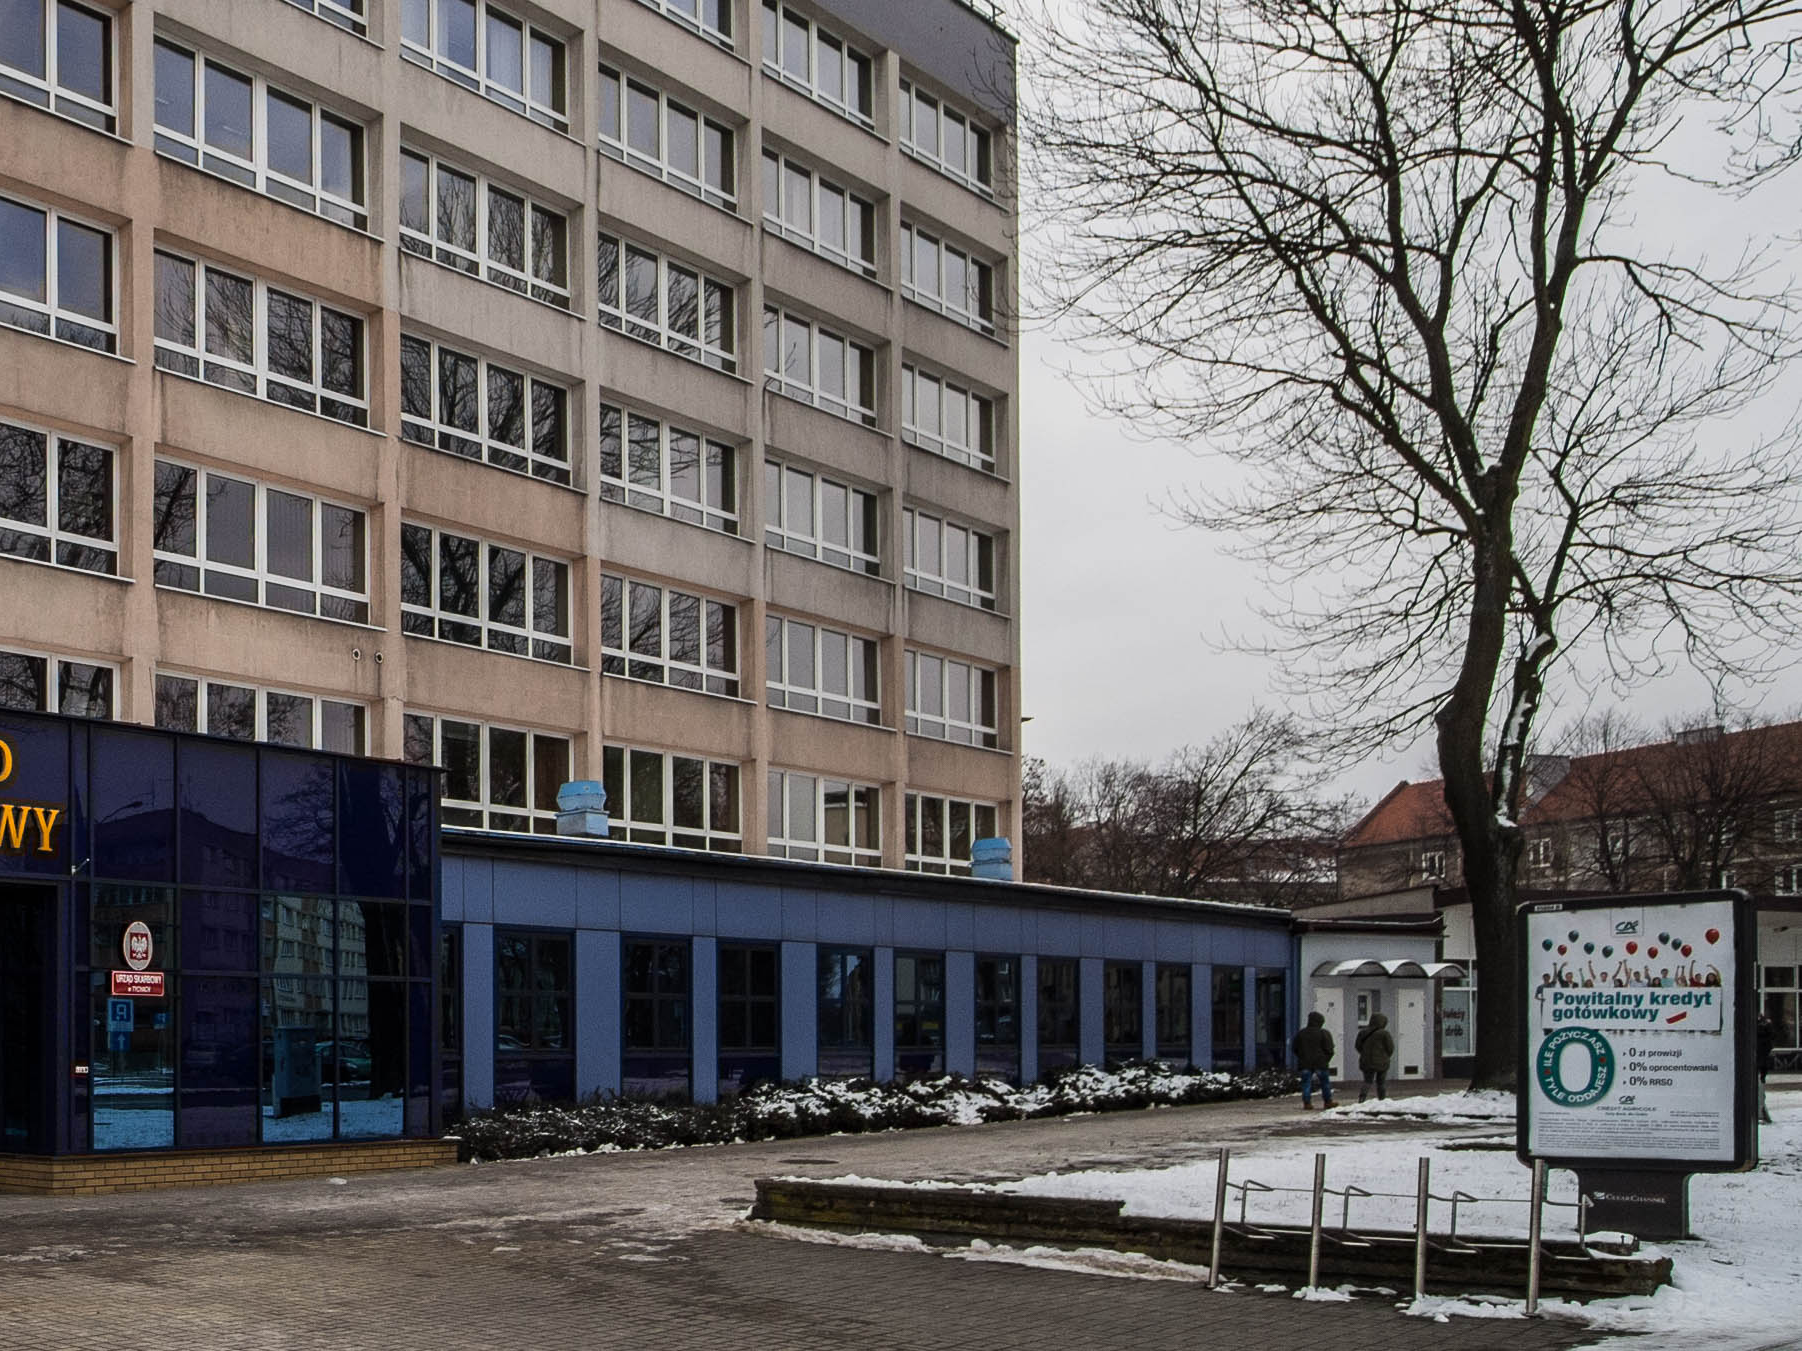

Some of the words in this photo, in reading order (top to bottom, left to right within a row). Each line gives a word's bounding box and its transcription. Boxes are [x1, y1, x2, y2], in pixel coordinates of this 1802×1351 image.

[1553, 992, 1644, 1008] Powitalny
[1650, 991, 1712, 1008] kredyt
[1552, 1005, 1659, 1022] gotówkowy
[1543, 1050, 1555, 1067] ILE
[1629, 1047, 1637, 1058] 0
[1648, 1050, 1682, 1059] prowizji
[1629, 1062, 1647, 1072] 0%
[1649, 1064, 1719, 1073] oprocentowania
[1545, 1076, 1567, 1100] TYLE
[1629, 1076, 1648, 1086] 0%
